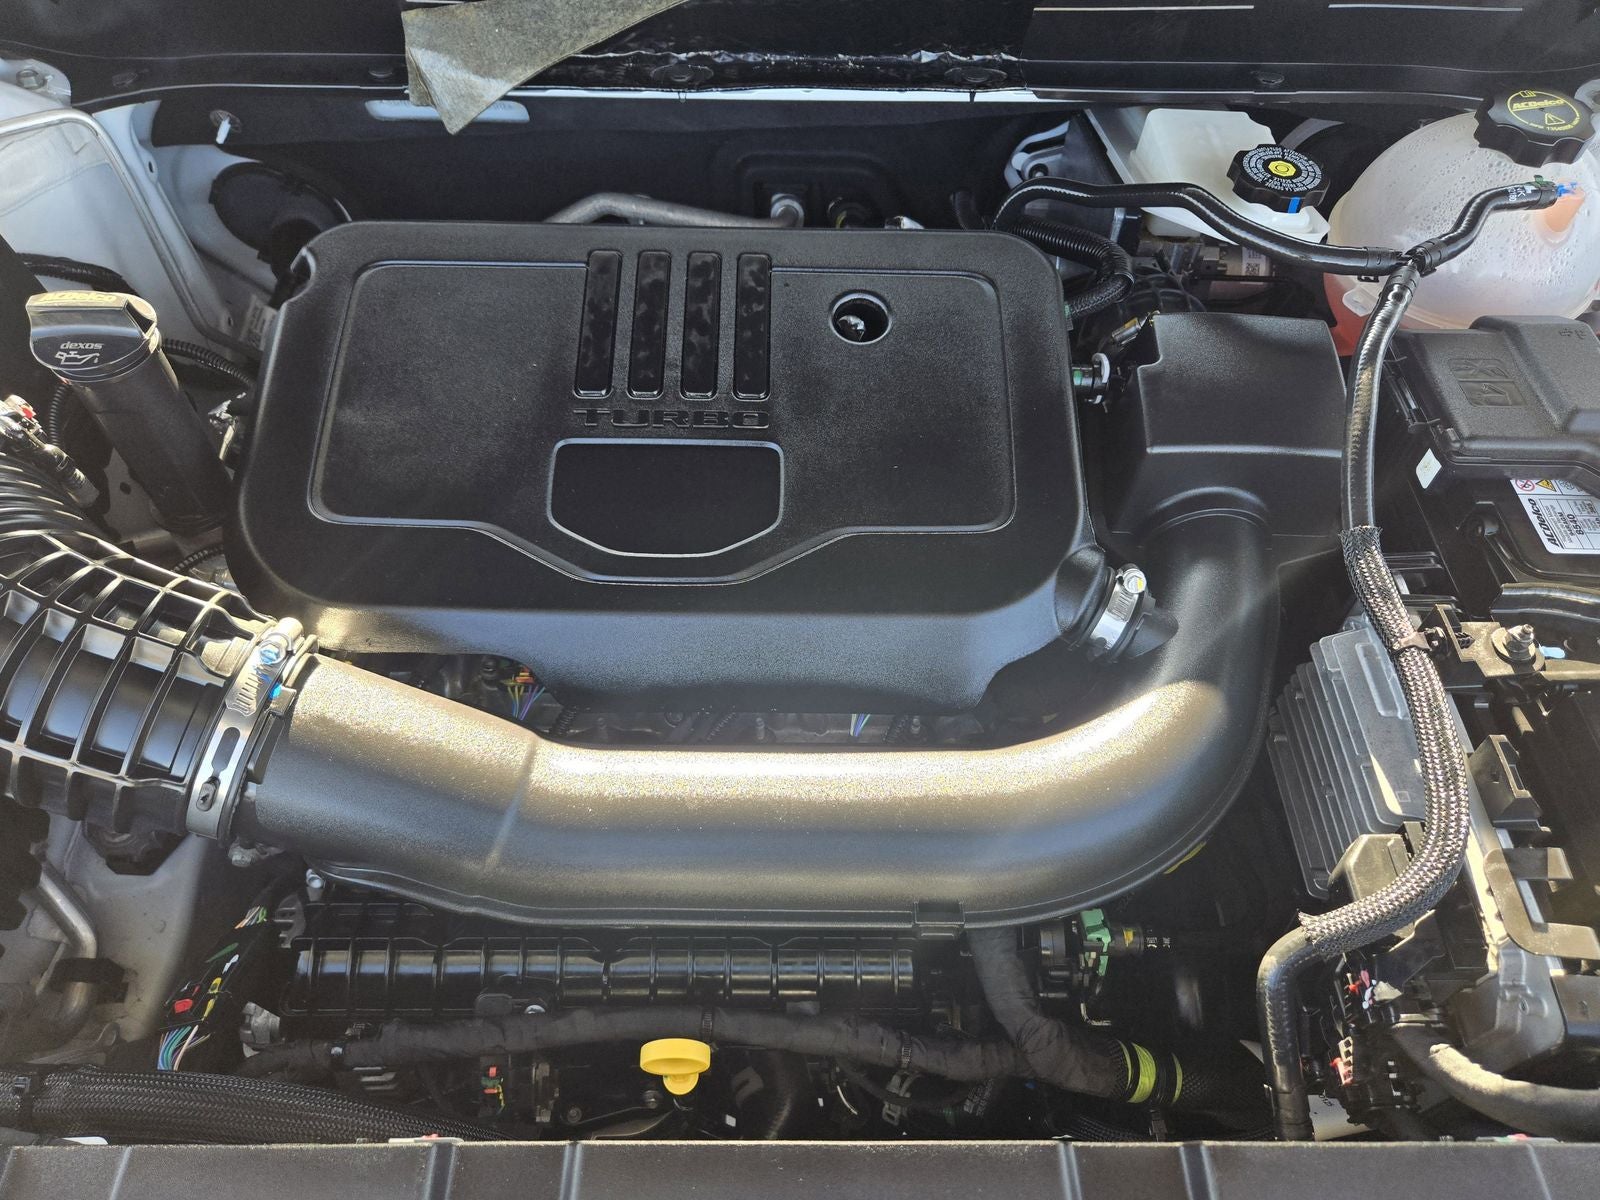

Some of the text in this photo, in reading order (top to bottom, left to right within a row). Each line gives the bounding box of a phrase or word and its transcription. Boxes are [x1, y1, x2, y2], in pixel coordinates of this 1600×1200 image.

[1512, 99, 1565, 110] ACDelco
[60, 341, 104, 350] dexos
[573, 407, 769, 429] TURBO
[1528, 498, 1560, 548] ACDelco
